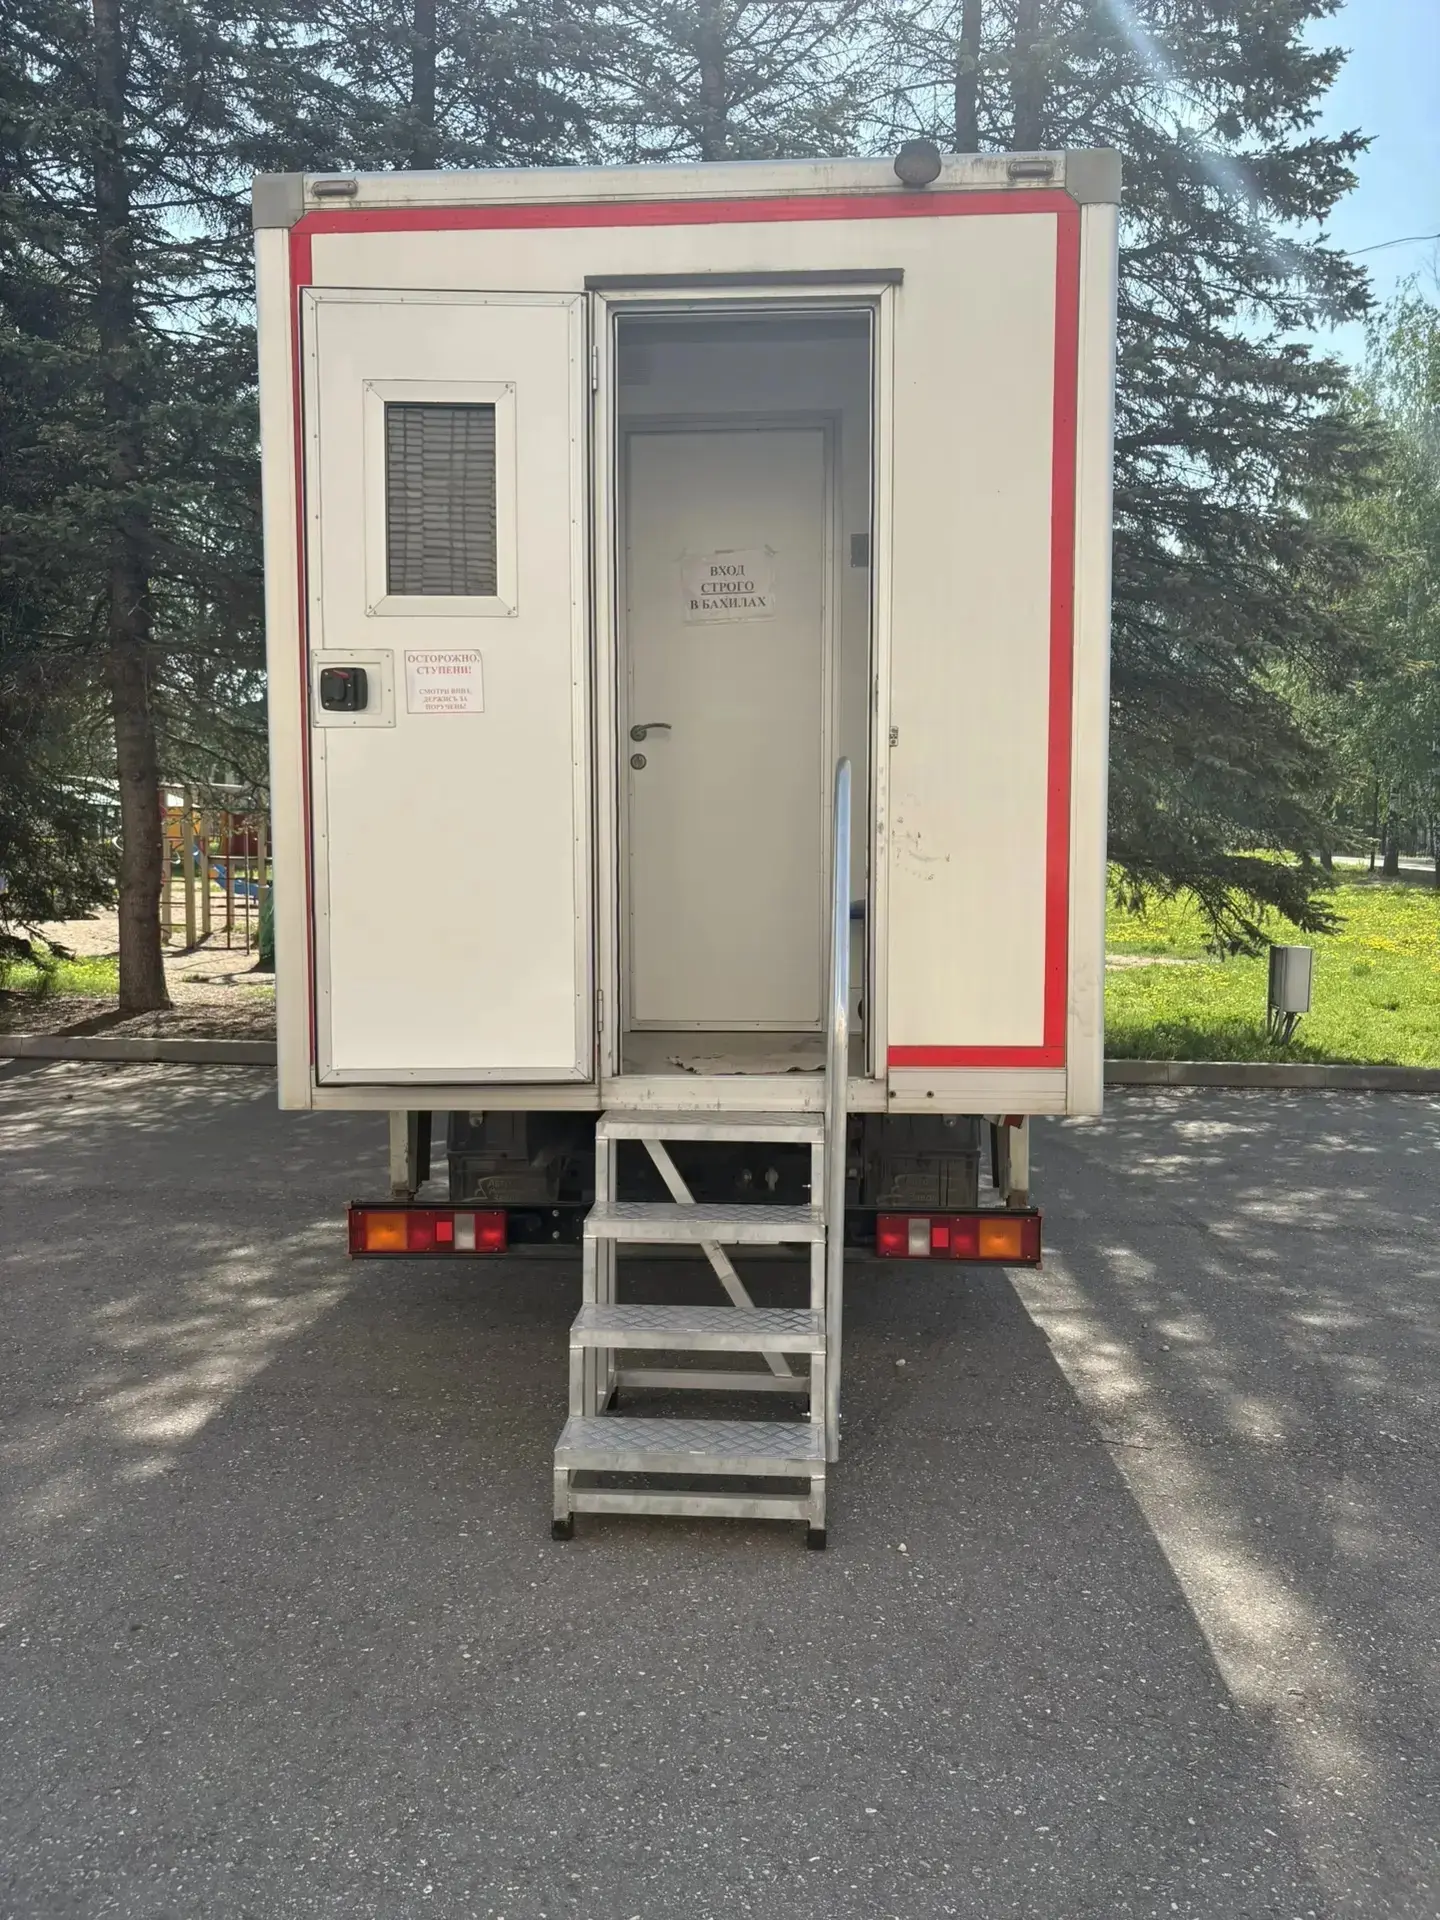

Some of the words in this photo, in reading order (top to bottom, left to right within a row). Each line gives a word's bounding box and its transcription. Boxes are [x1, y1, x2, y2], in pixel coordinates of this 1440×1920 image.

[710, 565, 745, 576] ВХОД
[701, 581, 754, 593] СТРОГО
[690, 600, 699, 610] В
[702, 597, 766, 609] БАХИЛАХ
[416, 666, 472, 674] СТУПЕНИ!
